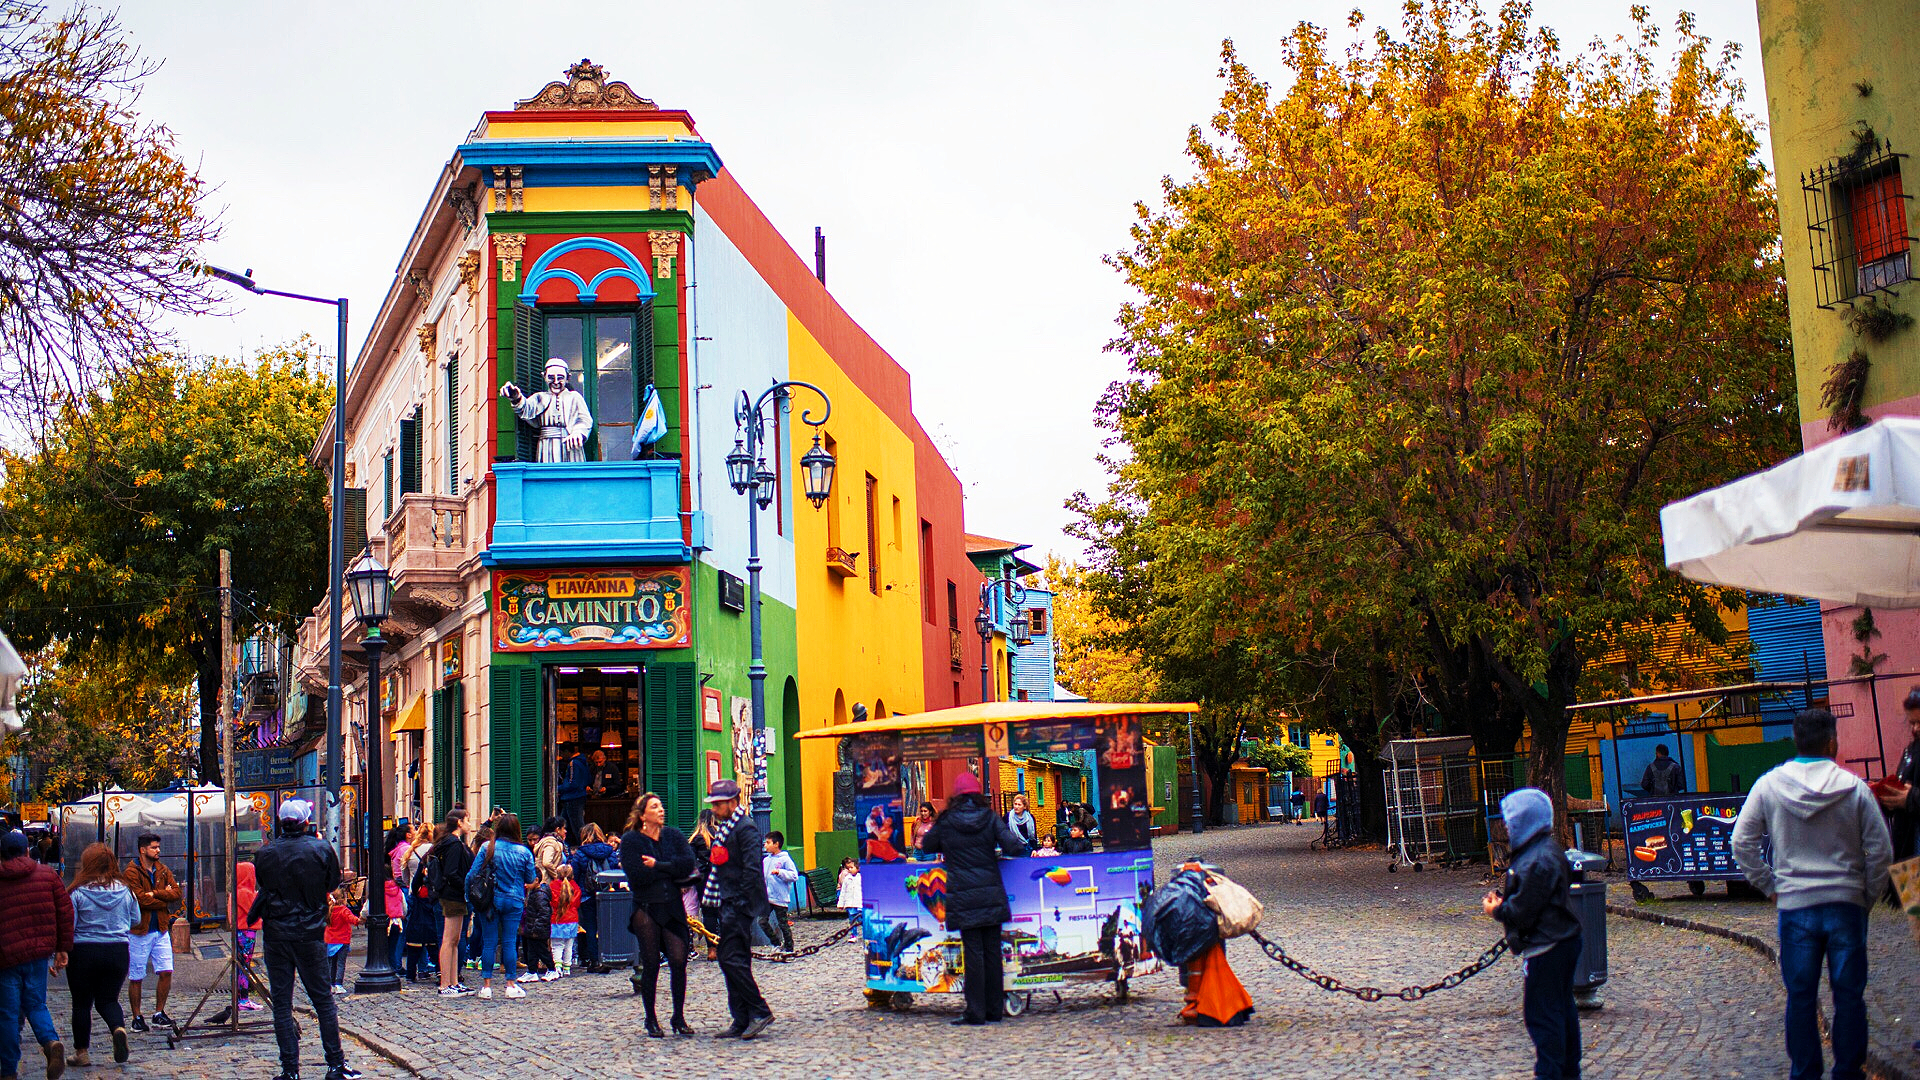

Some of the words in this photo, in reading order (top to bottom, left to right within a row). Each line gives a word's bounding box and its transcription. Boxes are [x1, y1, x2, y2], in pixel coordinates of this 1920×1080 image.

[556, 580, 628, 594] HAVANNA
[525, 595, 660, 625] CAMINITO
[1696, 805, 1737, 818] LICUADOS
[1629, 819, 1667, 832] SANDWICHES
[1088, 912, 1111, 920] GAUCHA
